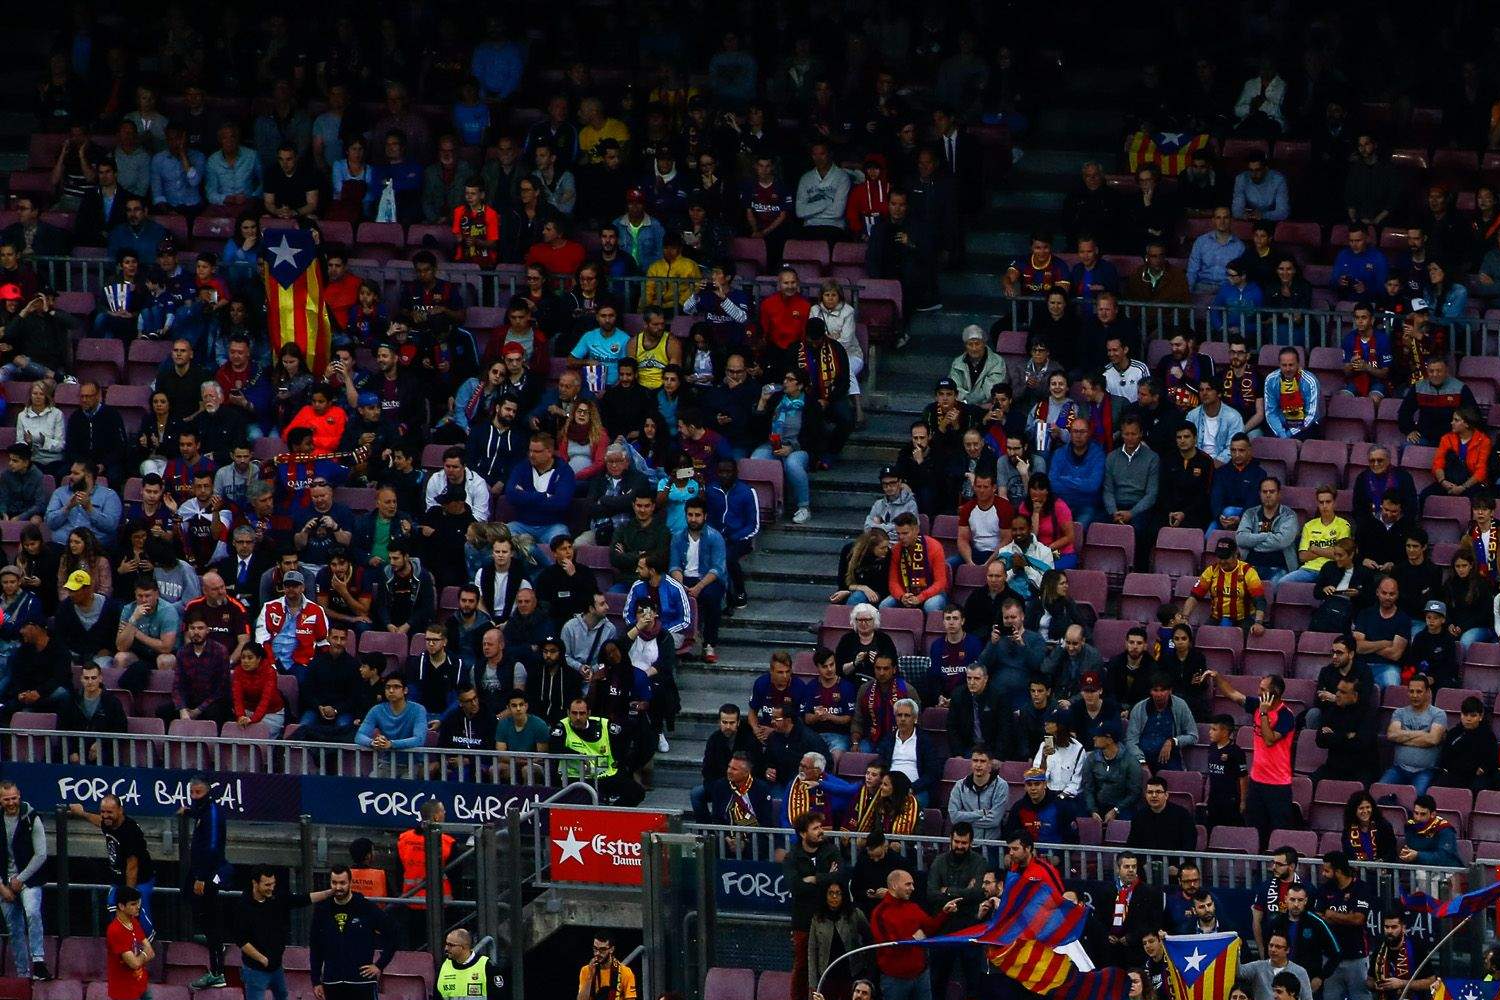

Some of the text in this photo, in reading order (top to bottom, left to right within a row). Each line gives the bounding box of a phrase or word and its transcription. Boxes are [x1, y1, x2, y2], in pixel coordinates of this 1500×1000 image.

[358, 791, 434, 823] FORÇ
[592, 833, 642, 856] Estre
[721, 871, 793, 904] FORÇ
